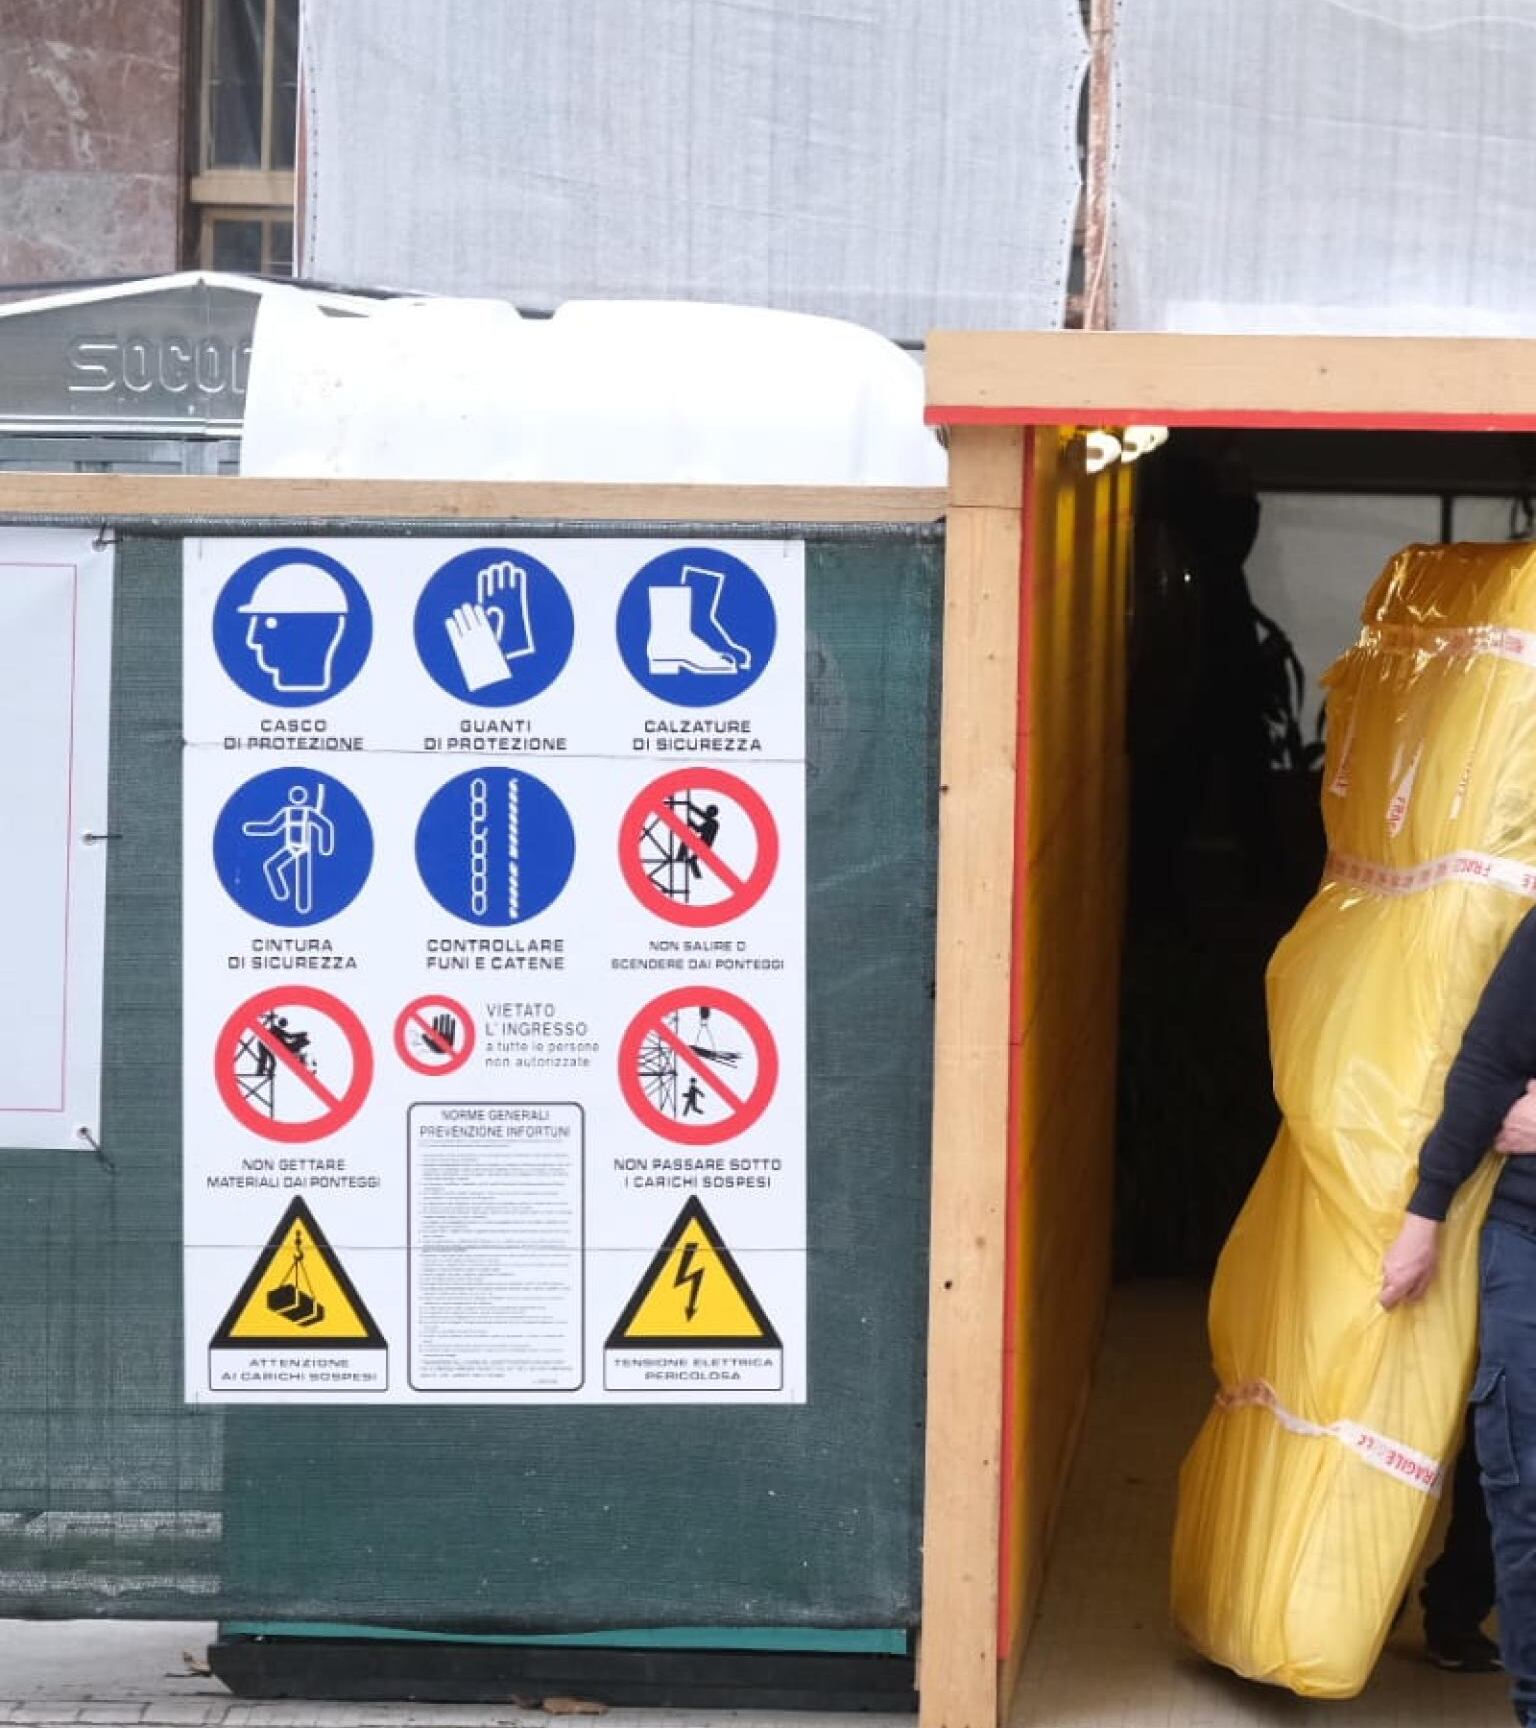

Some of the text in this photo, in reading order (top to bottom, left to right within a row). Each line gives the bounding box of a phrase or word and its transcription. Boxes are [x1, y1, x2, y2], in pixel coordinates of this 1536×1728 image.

[260, 718, 327, 733] CASCO
[460, 719, 531, 734] GUANTI
[644, 719, 751, 734] CALZATURE
[223, 735, 364, 752] DI PROTEZIONE
[423, 737, 567, 753] DI PROTEZIONE
[632, 737, 762, 752] DI SICUREZZA
[251, 938, 333, 953] CINTURA
[426, 938, 564, 954] CONTROLLARE
[648, 940, 681, 952] NON
[682, 940, 733, 952] SALIRE
[227, 956, 358, 970] DI SICUREZZA
[425, 956, 565, 971] FUNI E CATENE
[610, 958, 785, 971] SCENDERE DAI PONTEGGI
[486, 1002, 556, 1019] VIETATO
[496, 1041, 529, 1052] tutte
[531, 1040, 545, 1052] le
[547, 1039, 600, 1054] persone
[484, 1057, 511, 1068] non
[441, 1109, 550, 1122] NORME GENERALI
[419, 1125, 504, 1139] PREVENZIONE
[241, 1158, 346, 1171] NON GETTARE
[613, 1157, 782, 1171] NON PASSARE SOTTO
[206, 1175, 381, 1189] MATERIALI DAI PONTEGGI
[623, 1175, 771, 1189] I CARICHI SOSPESI
[248, 1357, 349, 1369] ATTENZIONE
[613, 1357, 774, 1369] TENSIONE ELETTRICA
[239, 1371, 306, 1382] CARICHI
[308, 1371, 377, 1383] SOSPESI
[644, 1370, 742, 1381] PERICOLOSA
